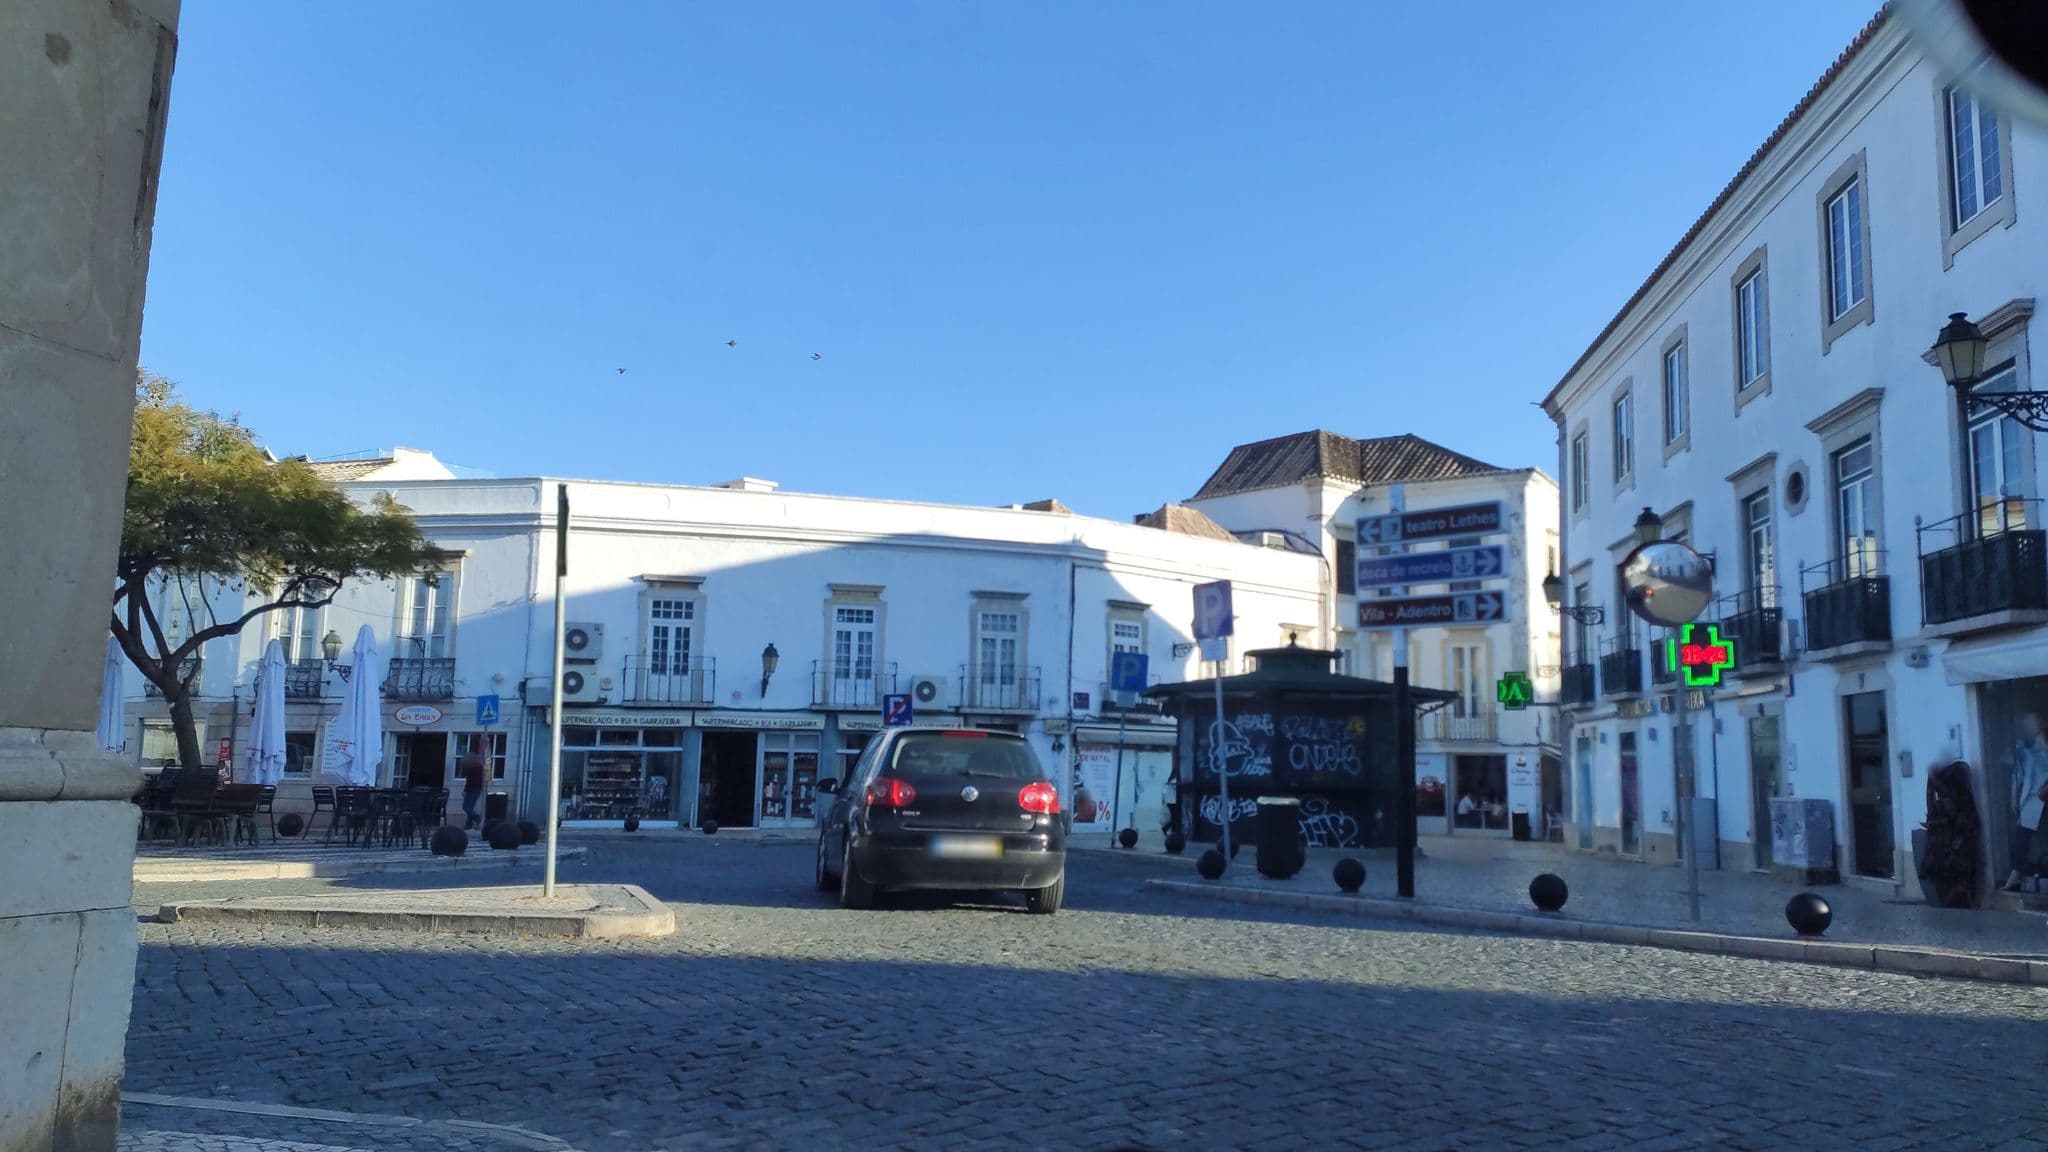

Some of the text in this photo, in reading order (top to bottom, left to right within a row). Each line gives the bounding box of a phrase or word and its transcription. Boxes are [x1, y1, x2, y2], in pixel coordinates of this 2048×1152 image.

[1407, 511, 1498, 533] teatro Lethes
[1360, 561, 1450, 580] doca de recreio
[1201, 588, 1223, 635] P
[1360, 606, 1385, 621] Vila
[1397, 603, 1451, 619] Adentro
[1119, 656, 1140, 687] P
[561, 716, 612, 724] UPERMERCADO
[620, 716, 632, 724] RUI
